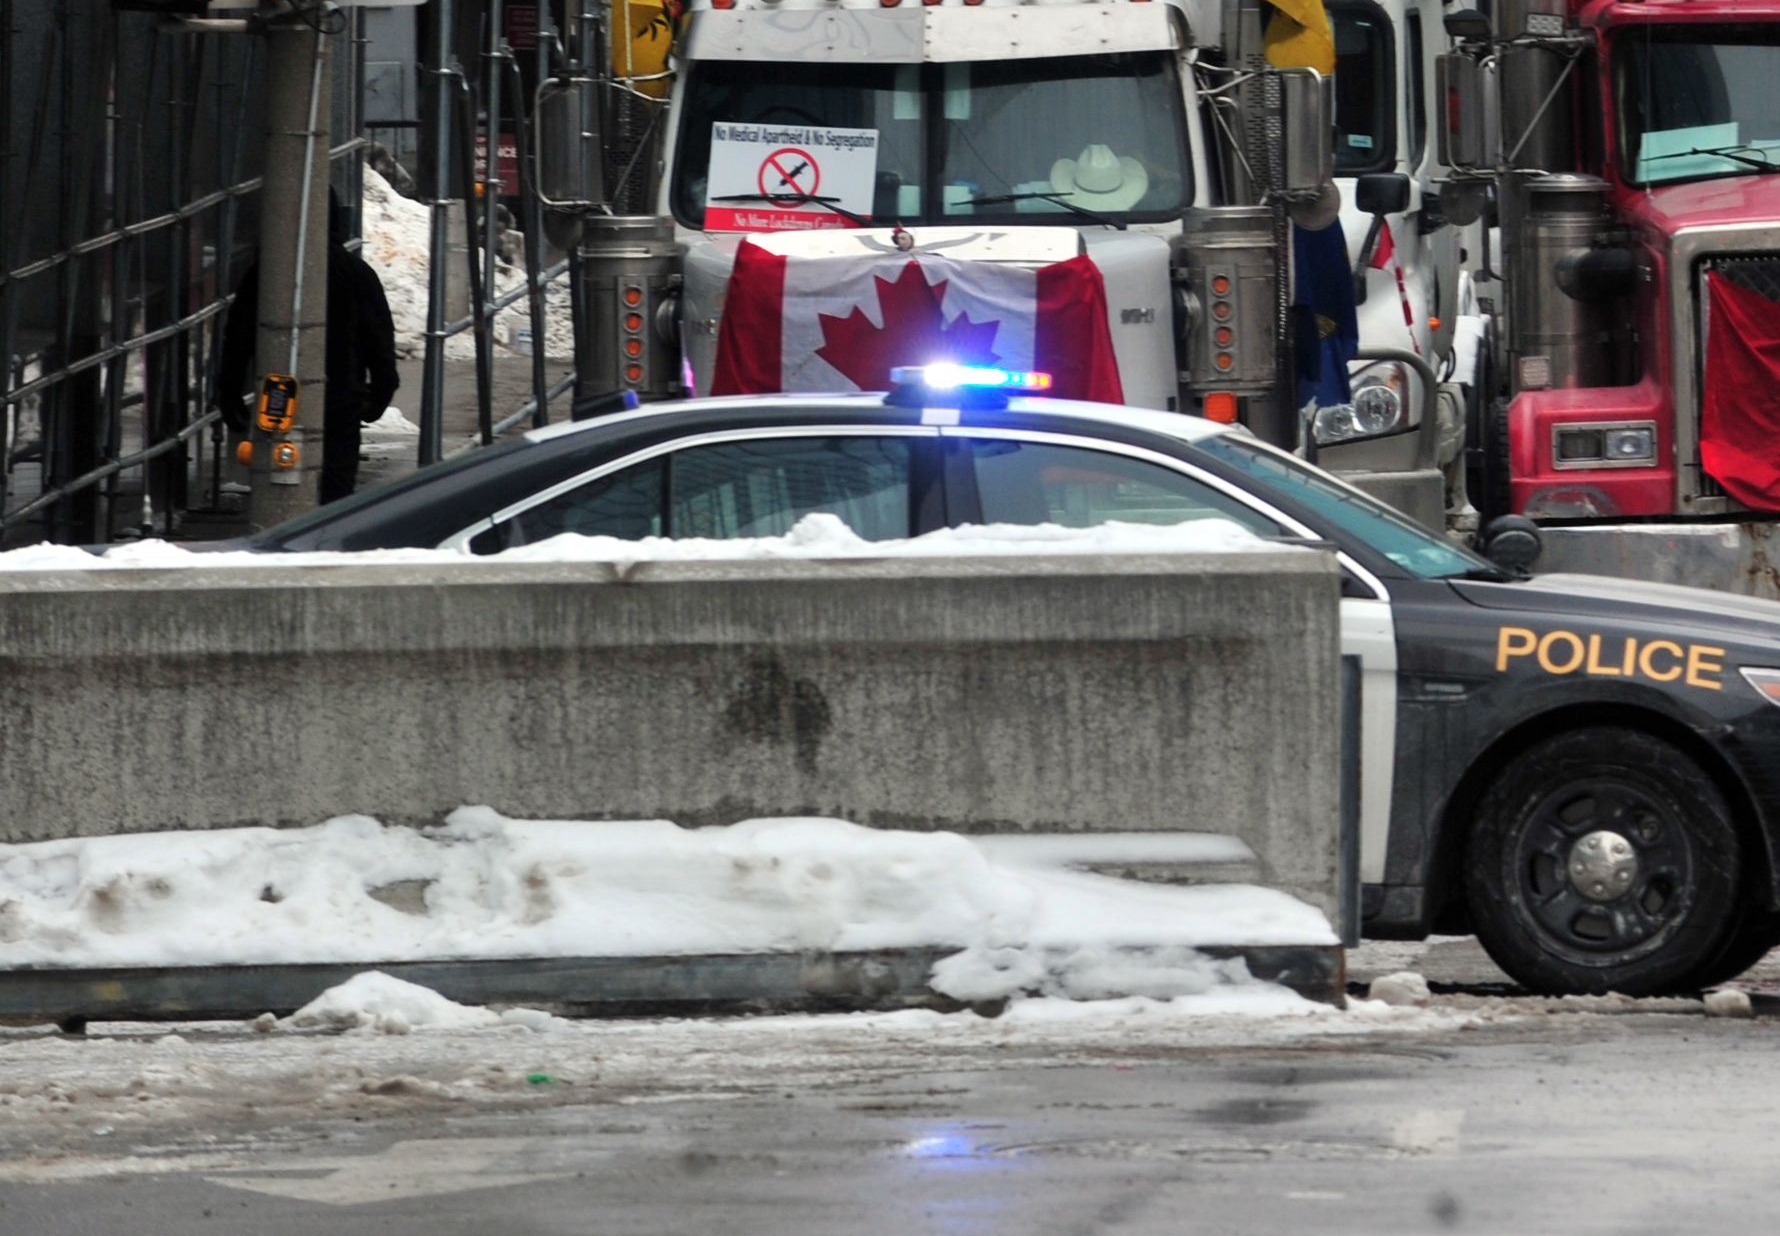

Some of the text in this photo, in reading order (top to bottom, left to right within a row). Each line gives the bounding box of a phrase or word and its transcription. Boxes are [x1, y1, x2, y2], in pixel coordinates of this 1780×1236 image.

[714, 125, 725, 141] No
[728, 125, 760, 142] Medical
[761, 127, 803, 145] Apartheid
[813, 130, 824, 145] No
[826, 131, 876, 151] Segregation
[1496, 627, 1726, 690] POLICE
